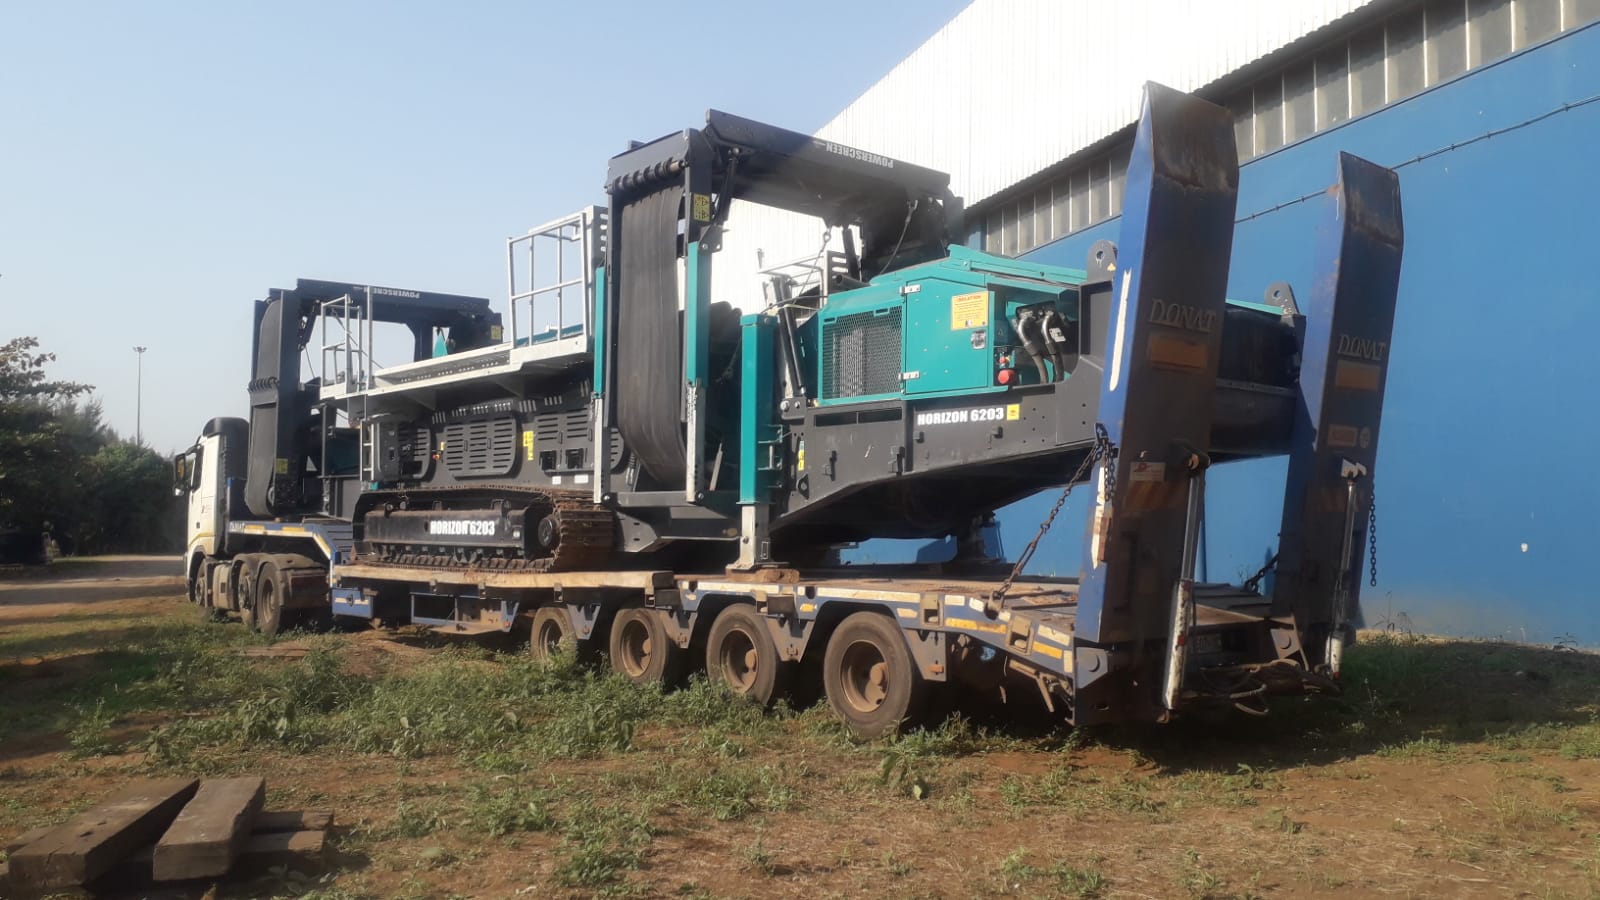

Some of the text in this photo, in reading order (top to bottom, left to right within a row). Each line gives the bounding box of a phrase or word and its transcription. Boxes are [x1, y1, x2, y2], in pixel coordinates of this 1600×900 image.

[826, 142, 894, 169] POWERSCREEN
[1150, 298, 1216, 331] DONAT
[1337, 334, 1387, 360] DONAT
[917, 407, 1004, 426] HORIZON 6203
[469, 520, 495, 536] 6203
